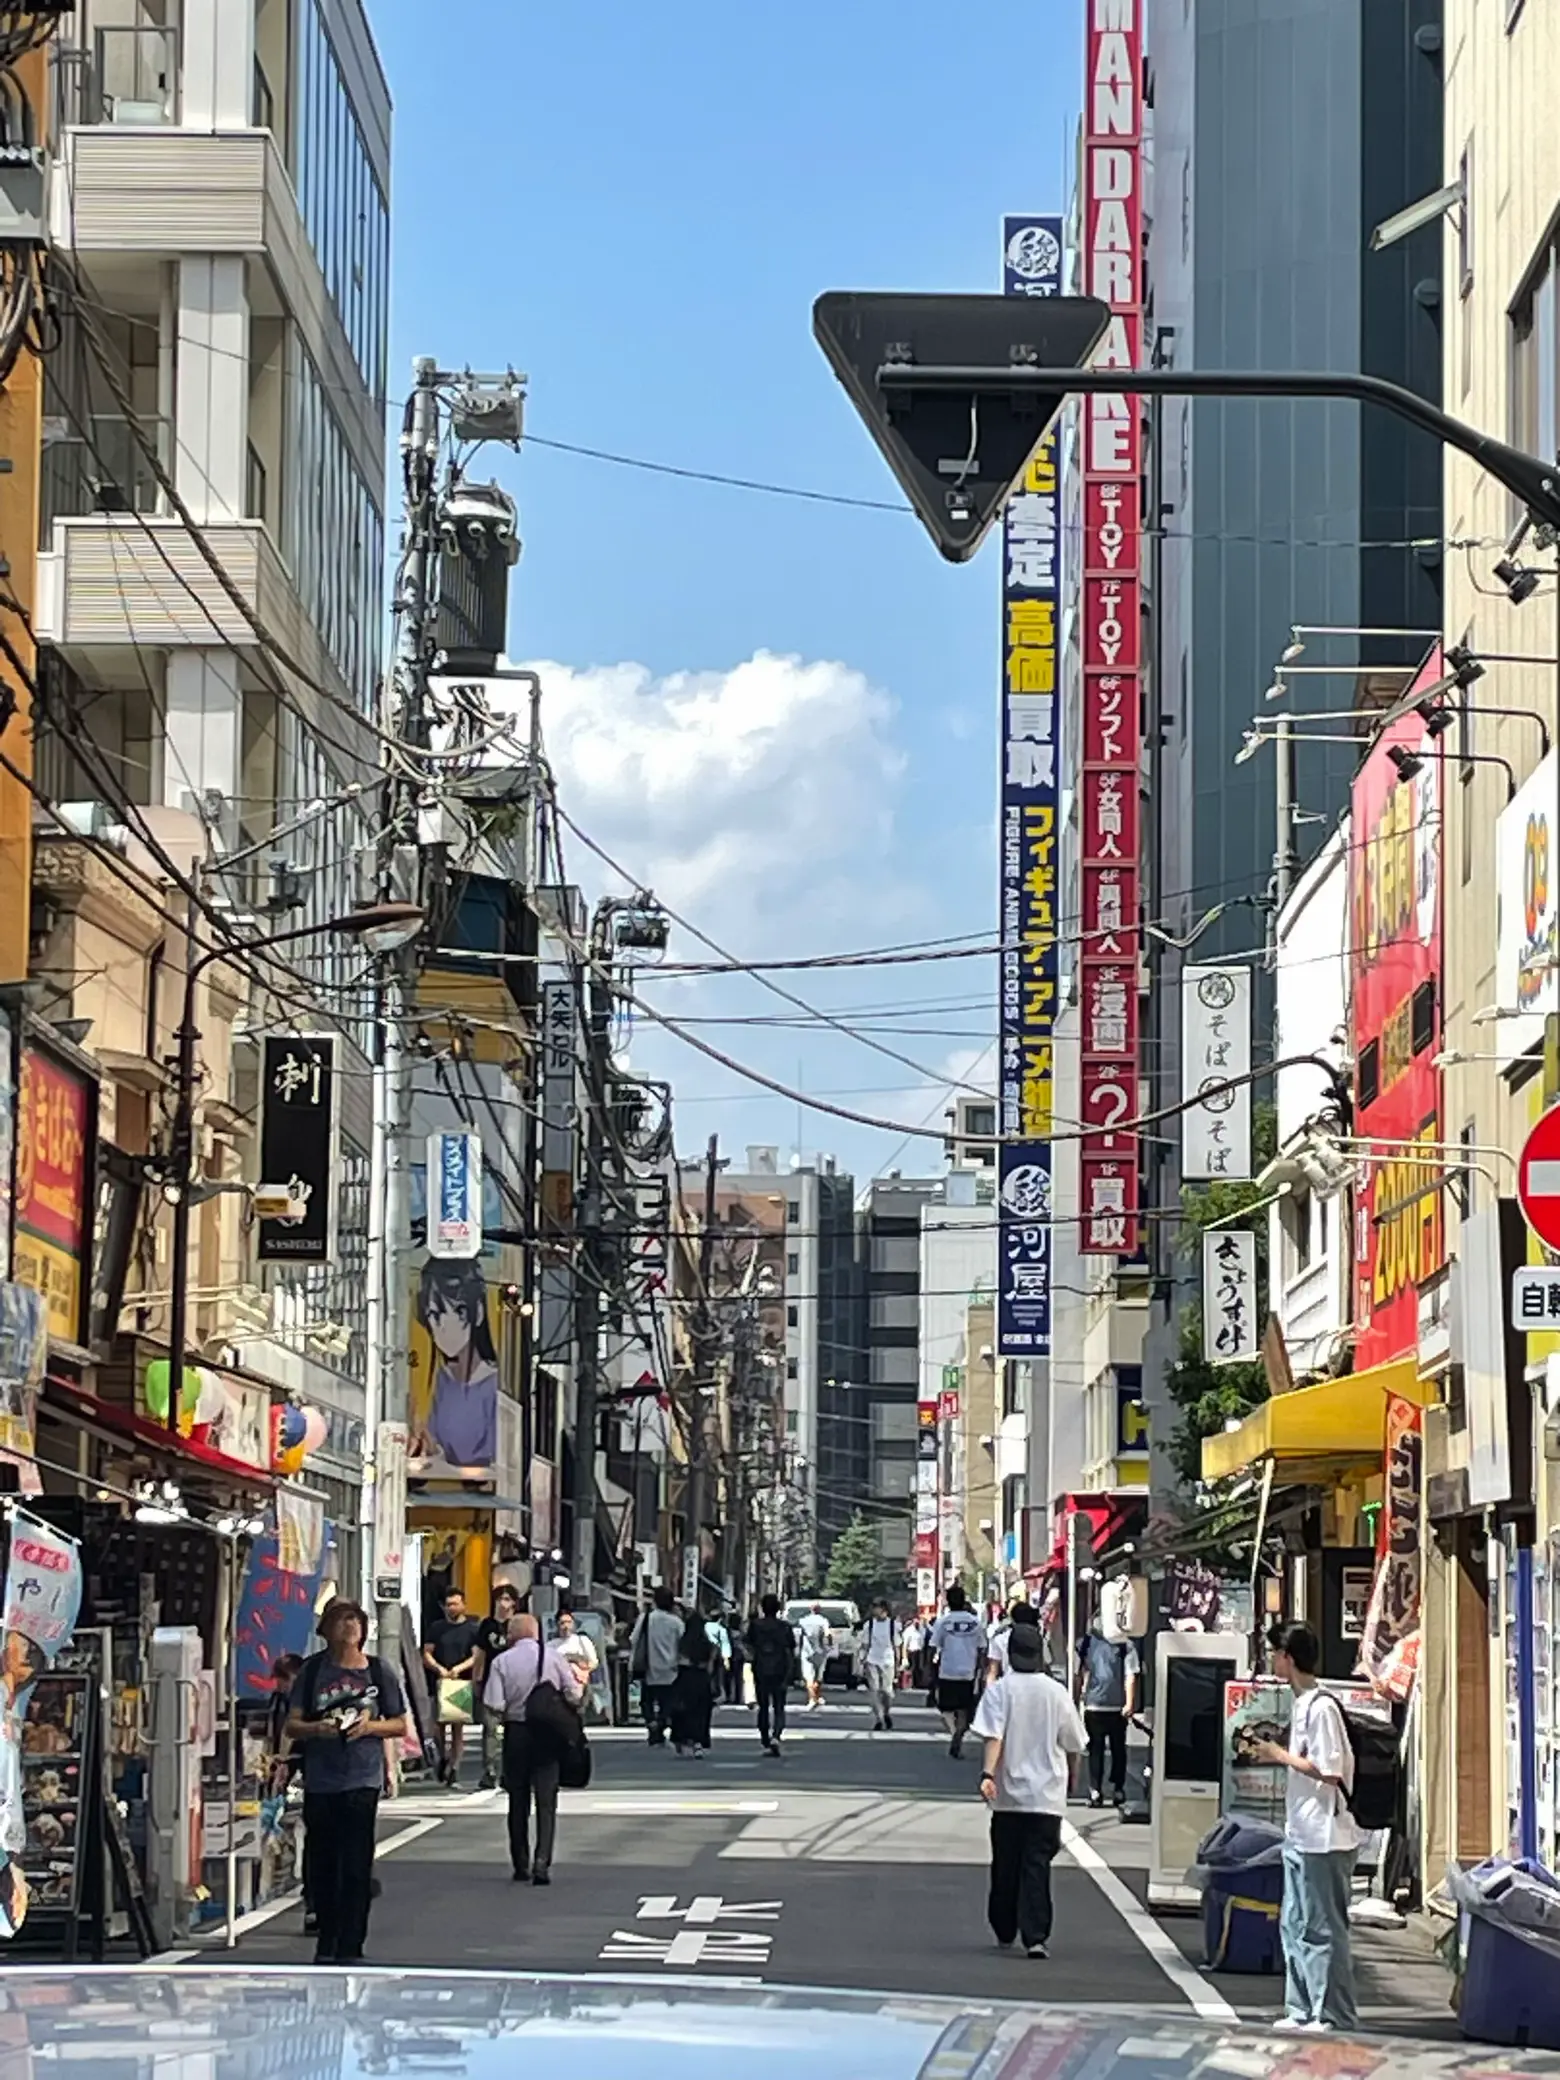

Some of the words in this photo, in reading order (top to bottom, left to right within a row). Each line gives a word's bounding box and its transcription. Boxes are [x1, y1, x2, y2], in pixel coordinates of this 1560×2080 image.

[1099, 499, 1122, 568] TOY
[1099, 596, 1122, 665] TOY
[1099, 692, 1122, 760] ソフト
[1206, 1016, 1232, 1067] そば
[1206, 1121, 1232, 1173] そば
[1090, 1178, 1126, 1247] 買取
